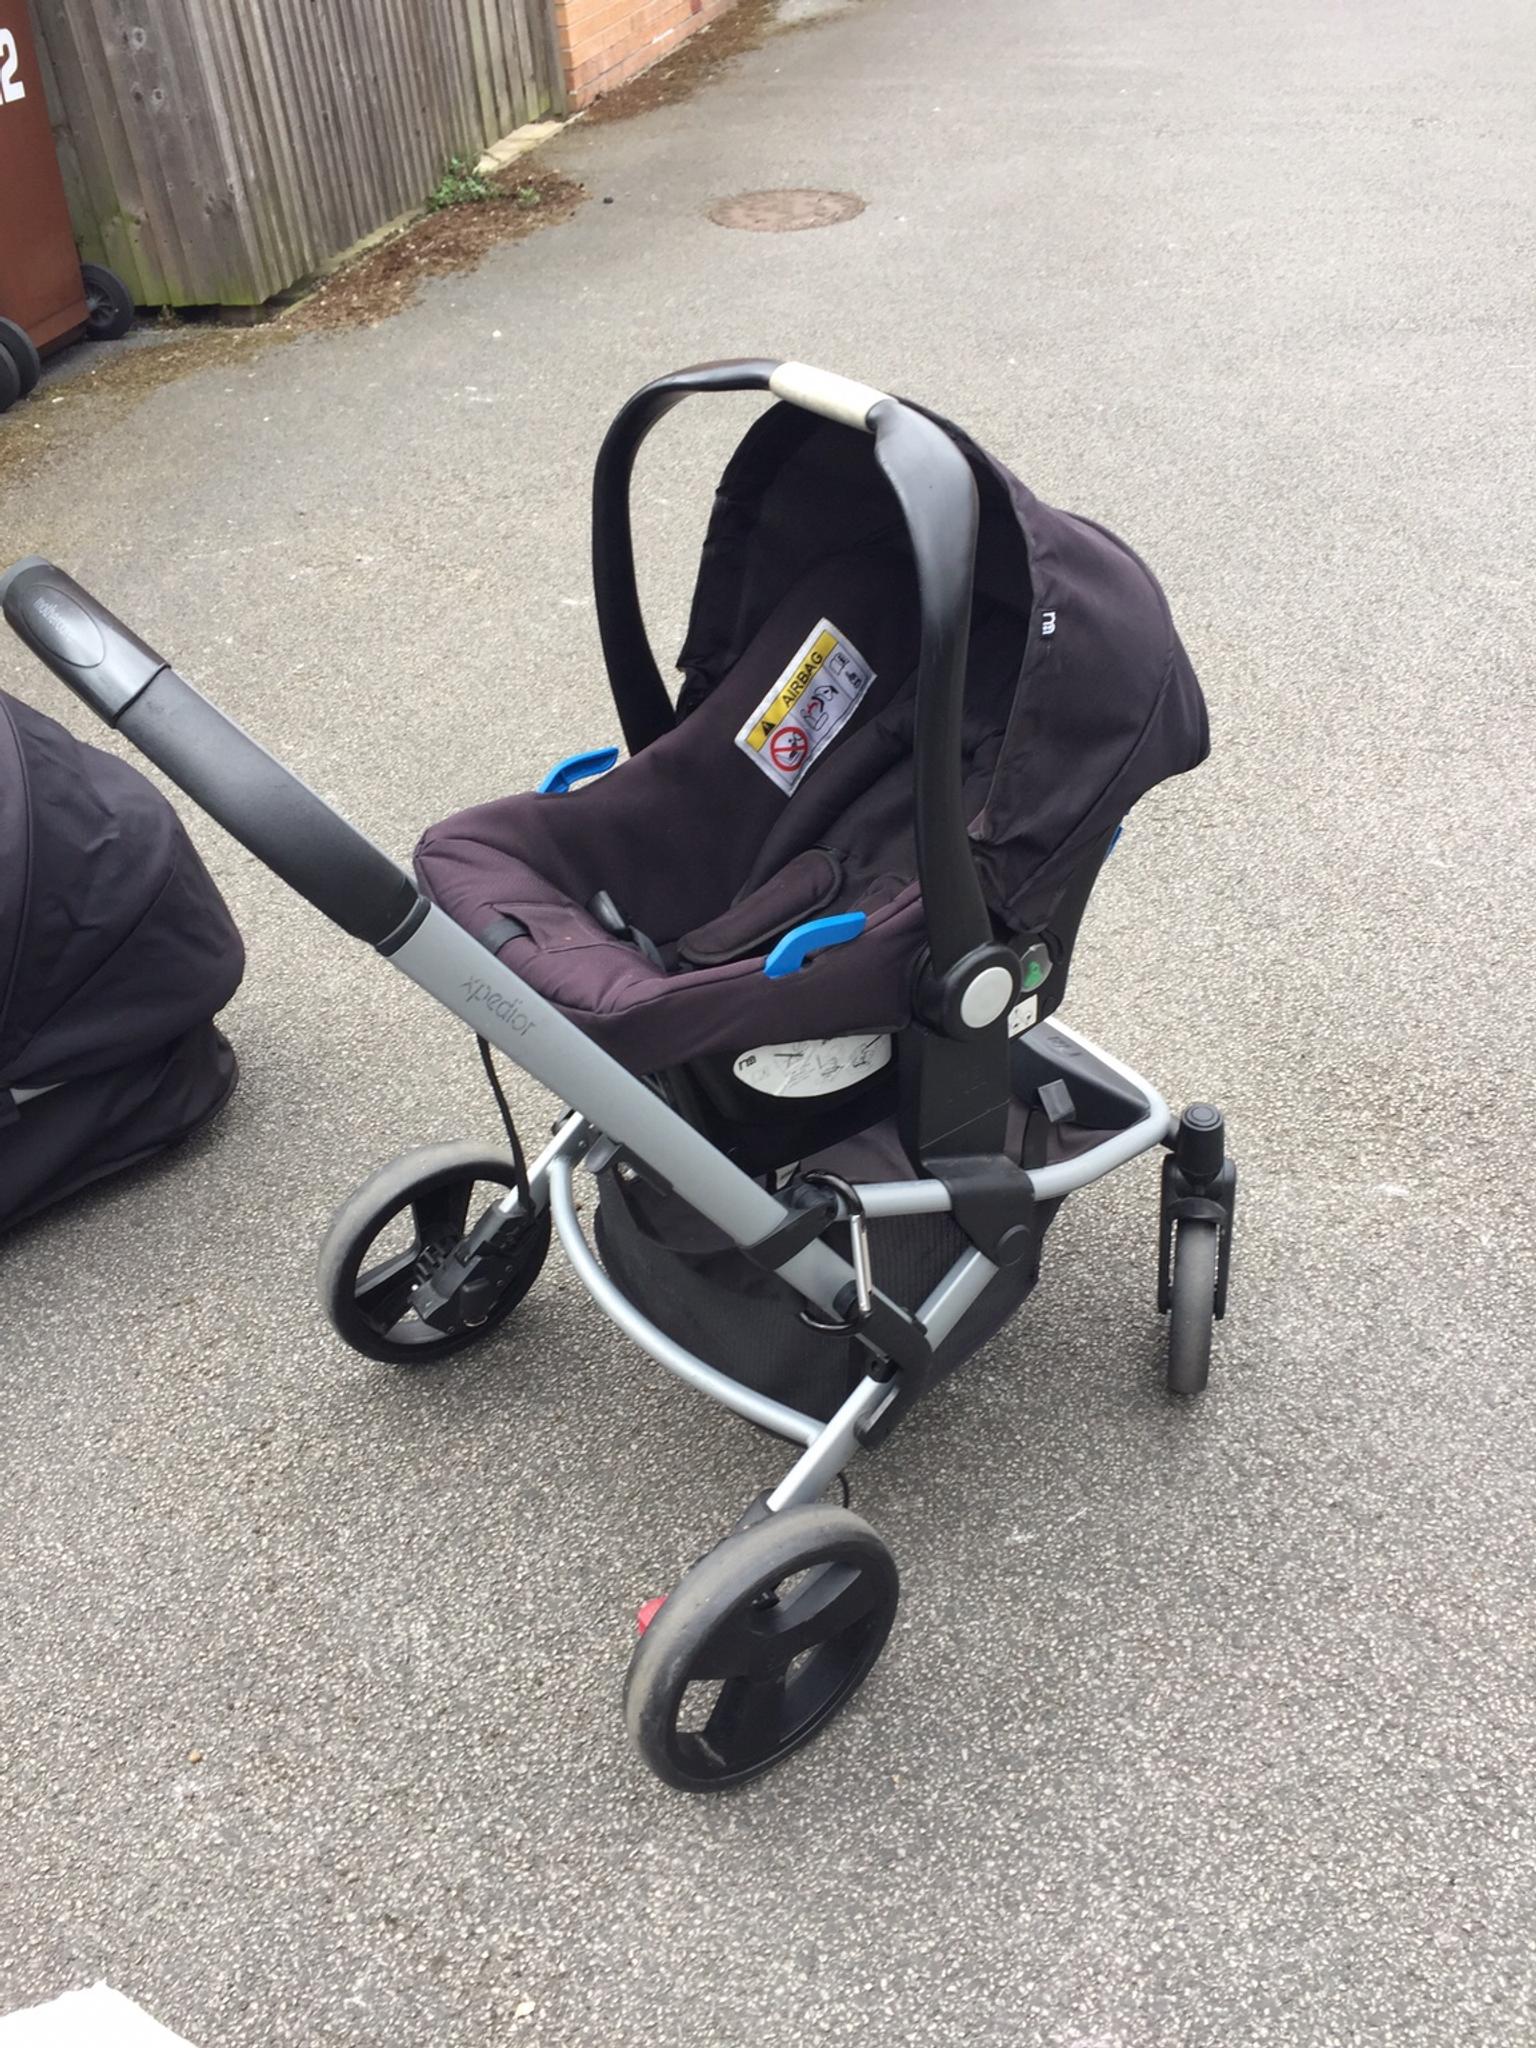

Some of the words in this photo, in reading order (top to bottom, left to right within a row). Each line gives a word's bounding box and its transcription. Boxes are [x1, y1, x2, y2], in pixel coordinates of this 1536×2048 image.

[0, 27, 26, 106] 2
[782, 651, 823, 708] AIRBAG
[459, 975, 536, 1036] xpedior
